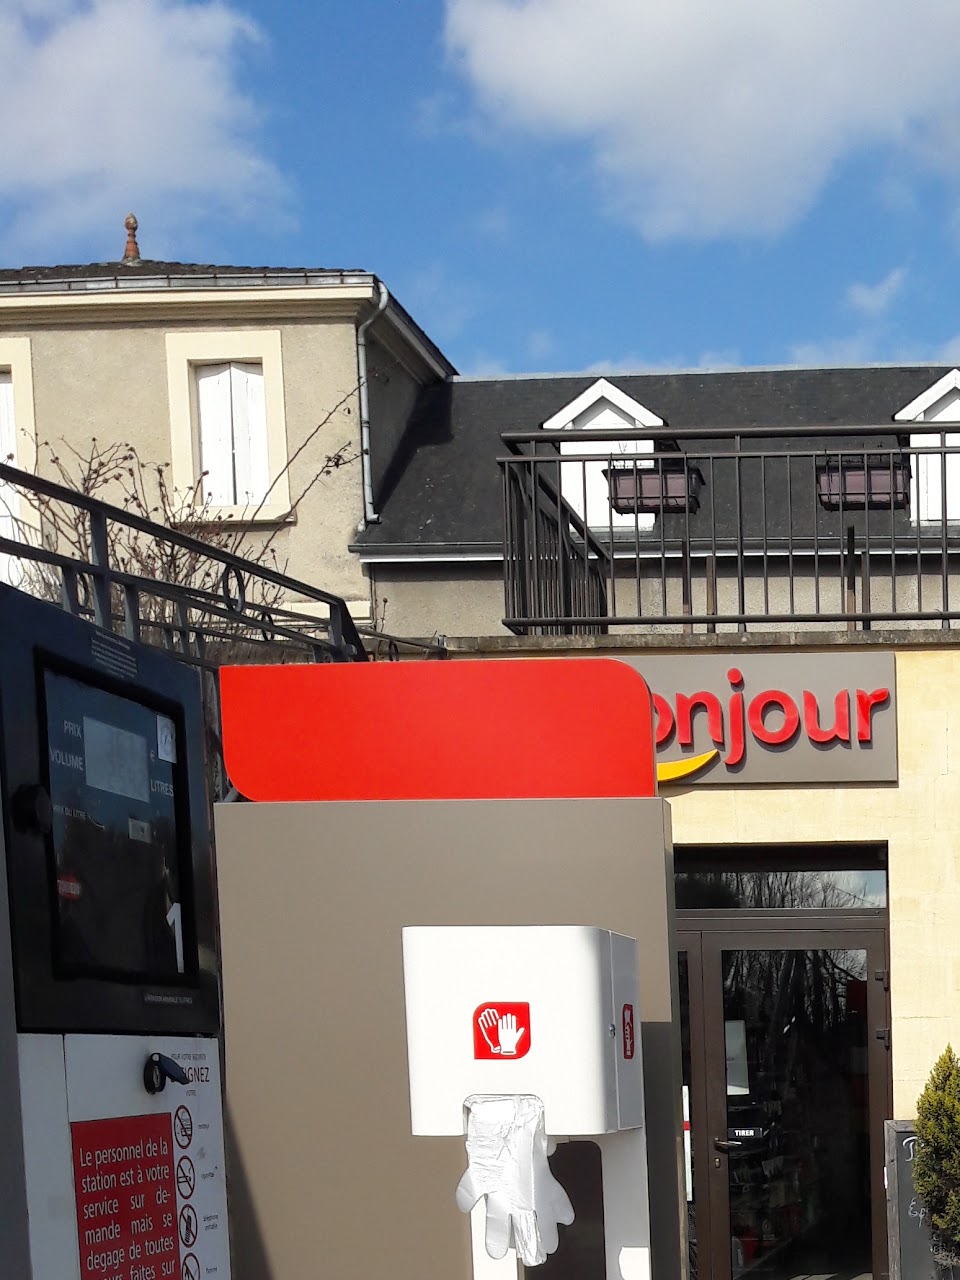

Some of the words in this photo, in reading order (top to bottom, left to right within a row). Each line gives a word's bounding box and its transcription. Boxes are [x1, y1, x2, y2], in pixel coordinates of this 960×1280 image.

[64, 719, 82, 739] PRIX
[49, 745, 84, 771] VOLUME
[150, 779, 174, 797] LITRES
[165, 902, 185, 974] 1
[734, 1128, 755, 1137] TIRER
[80, 1147, 92, 1167] Le
[95, 1138, 144, 1170] personnel
[145, 1137, 158, 1157] de
[160, 1136, 168, 1156] la
[82, 1171, 117, 1193] station
[119, 1167, 135, 1187] est
[137, 1164, 143, 1183] à
[145, 1163, 170, 1182] votre
[83, 1196, 119, 1219] service
[130, 1193, 145, 1210] sur
[156, 1185, 171, 1205] de-
[85, 1219, 121, 1245] mande
[131, 1213, 154, 1235] mais
[162, 1212, 172, 1227] se
[86, 1249, 125, 1273] degage
[129, 1240, 141, 1260] de
[145, 1235, 175, 1256] toutes
[161, 1259, 176, 1276] sur
